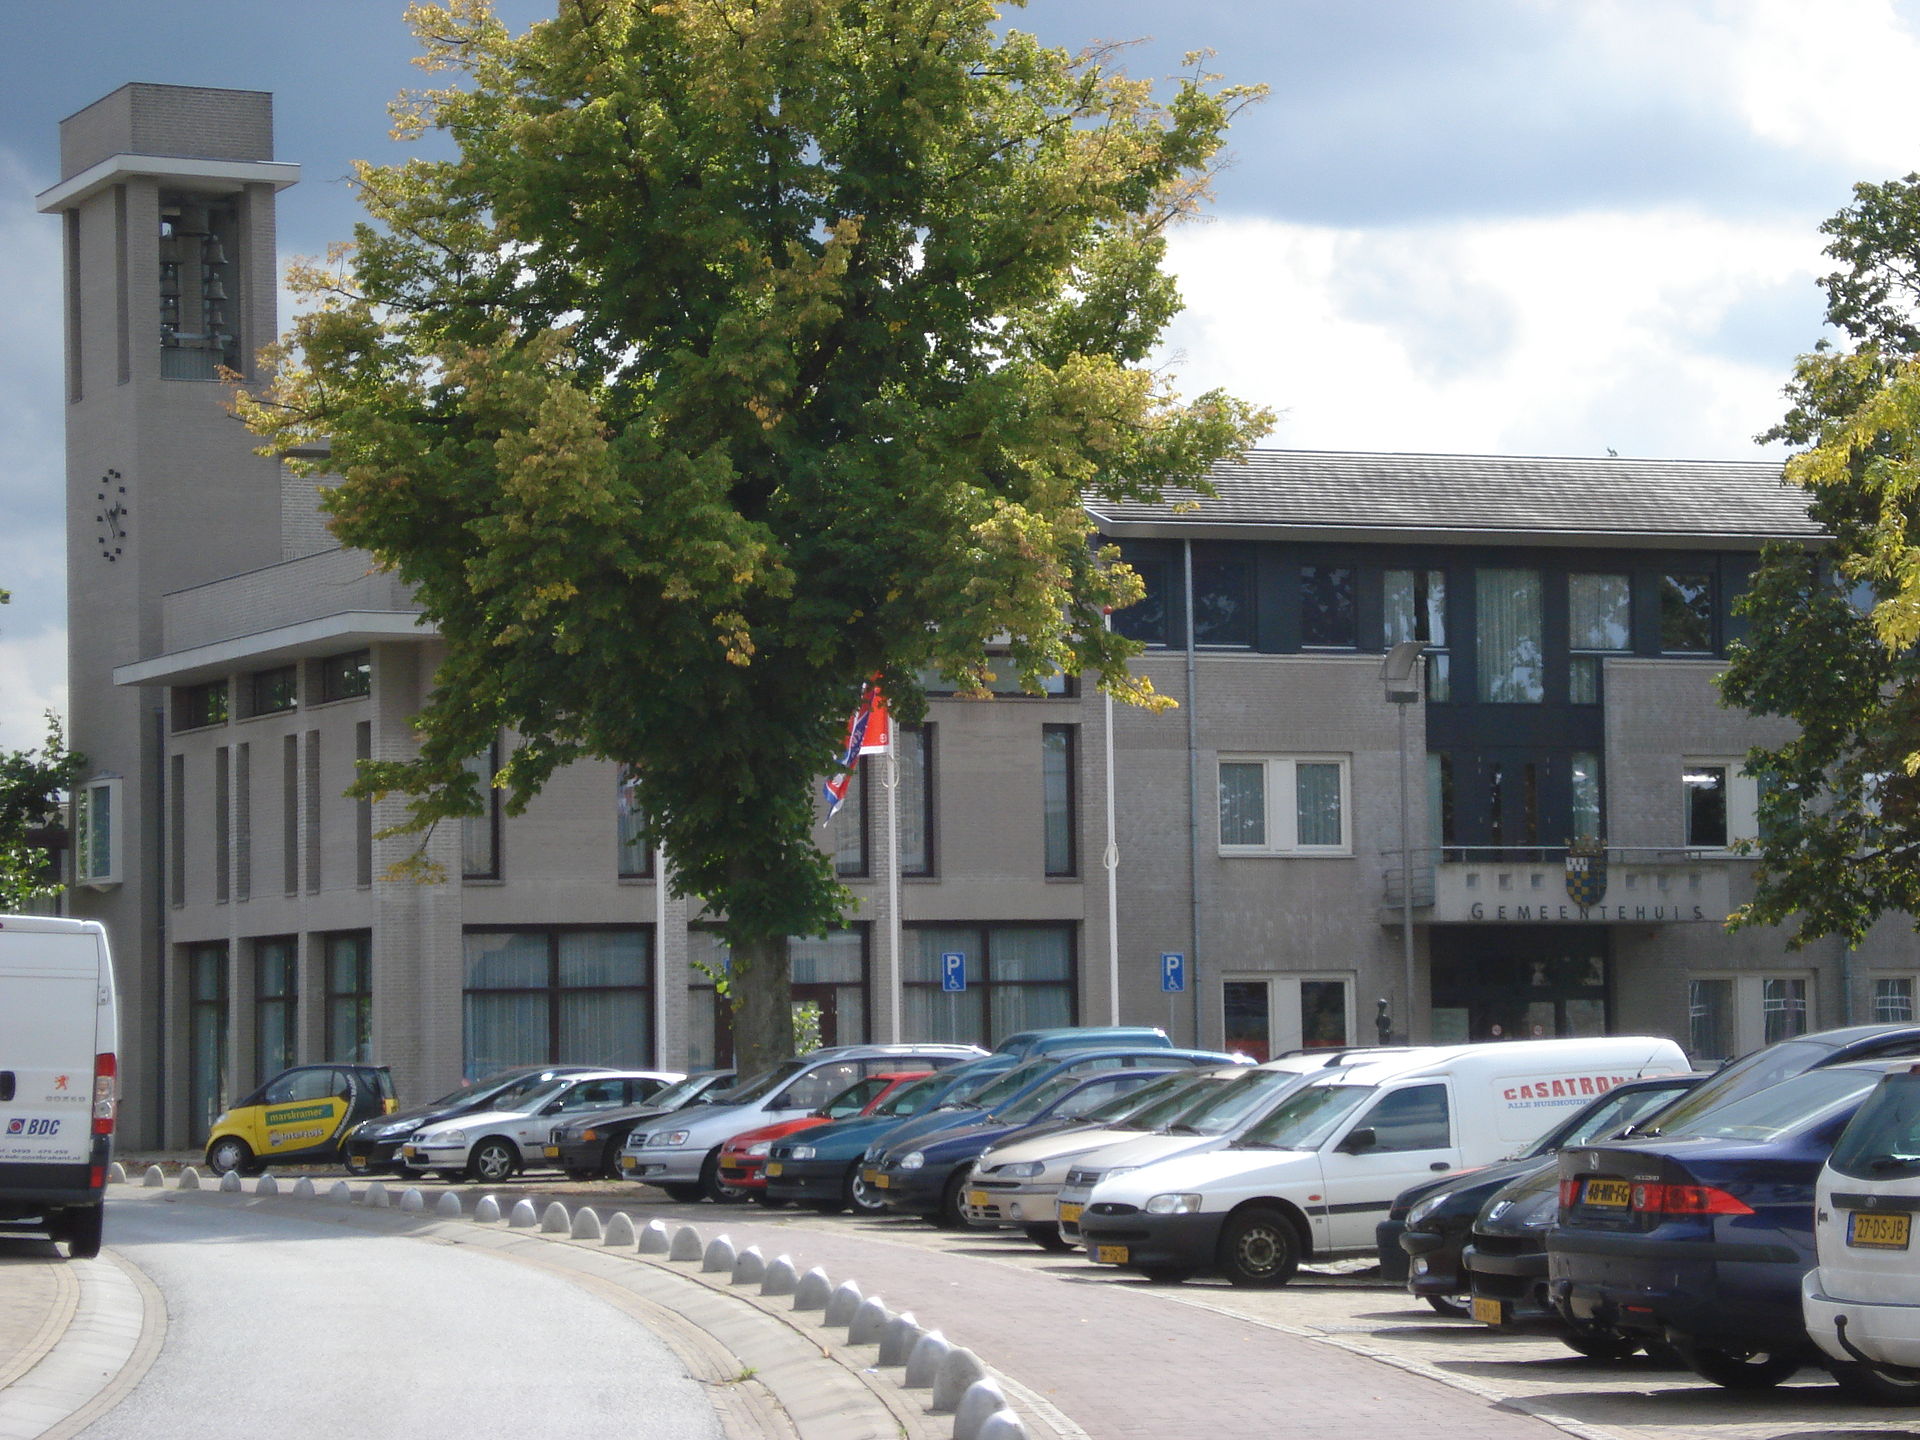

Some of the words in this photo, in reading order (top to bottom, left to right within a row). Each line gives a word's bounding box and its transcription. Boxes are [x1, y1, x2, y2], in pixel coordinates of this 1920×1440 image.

[1470, 901, 1704, 920] GEMEENTEHUIS
[946, 955, 960, 976] P
[1166, 956, 1180, 976] P
[1534, 1098, 1592, 1108] HUISHOUDE
[270, 1108, 323, 1121] marskramer
[27, 1119, 61, 1135] BDC
[1857, 1218, 1904, 1240] 27-DS-JB
